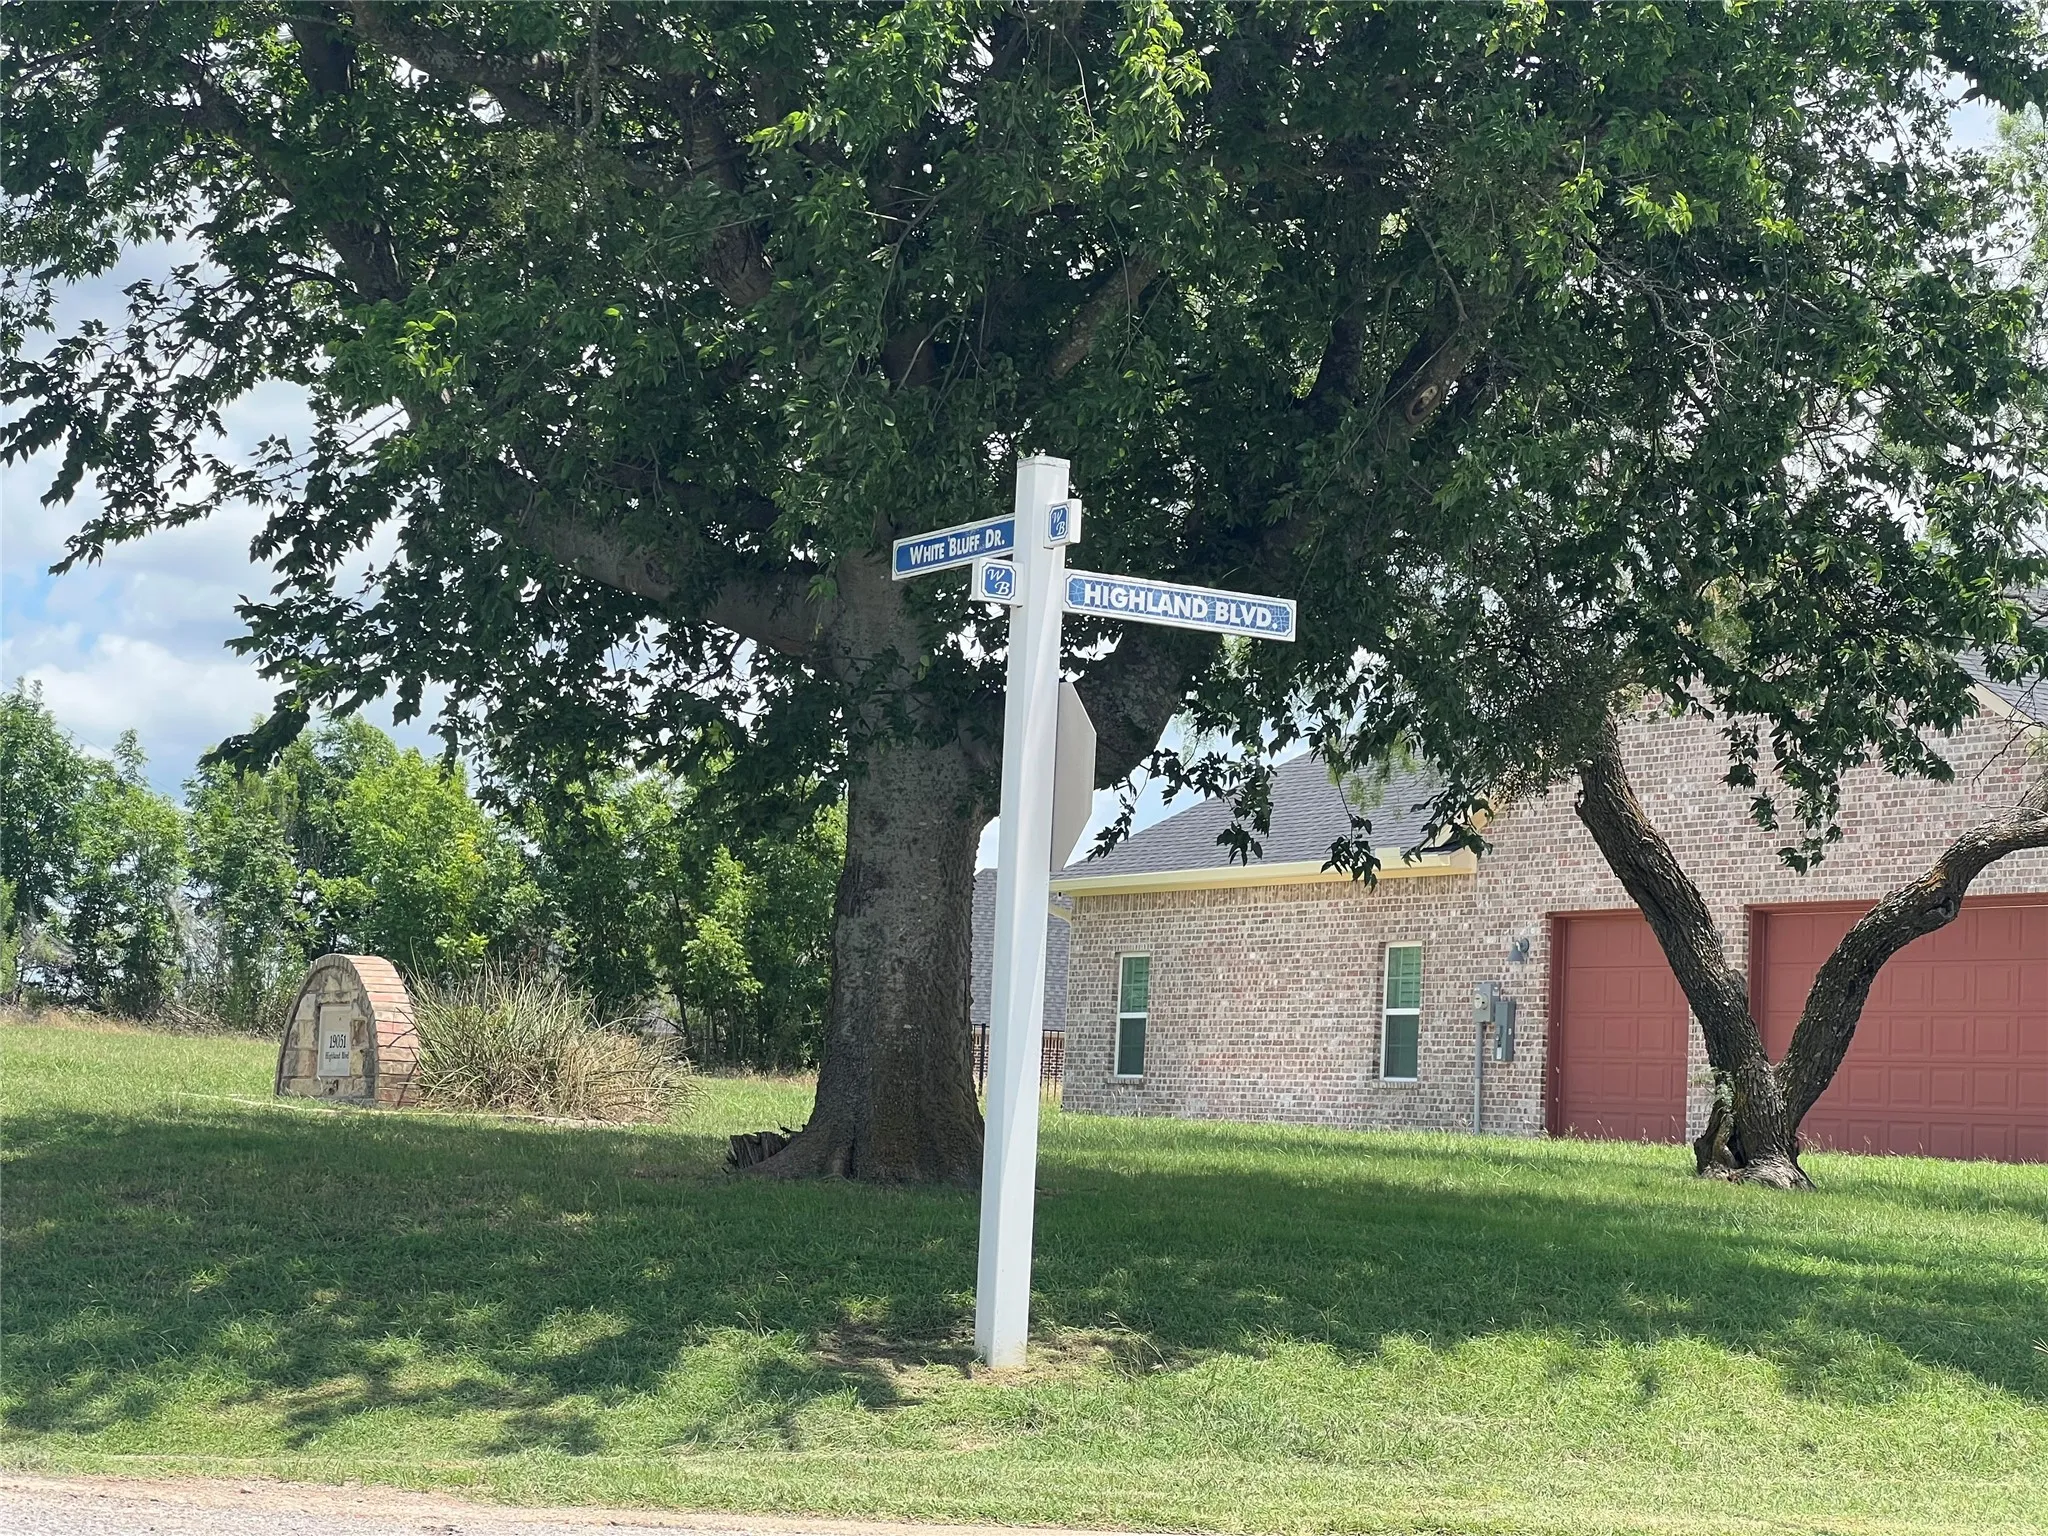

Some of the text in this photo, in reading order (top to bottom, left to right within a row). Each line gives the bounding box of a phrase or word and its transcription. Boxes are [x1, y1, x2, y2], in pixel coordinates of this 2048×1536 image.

[1052, 509, 1063, 524] W
[1055, 521, 1065, 536] B
[909, 529, 1006, 565] WHITE BLUFF DR.
[987, 568, 1005, 581] W
[994, 581, 1010, 595] B
[1084, 582, 1278, 630] HIGHLAND BLVD.
[329, 1034, 347, 1049] 19051
